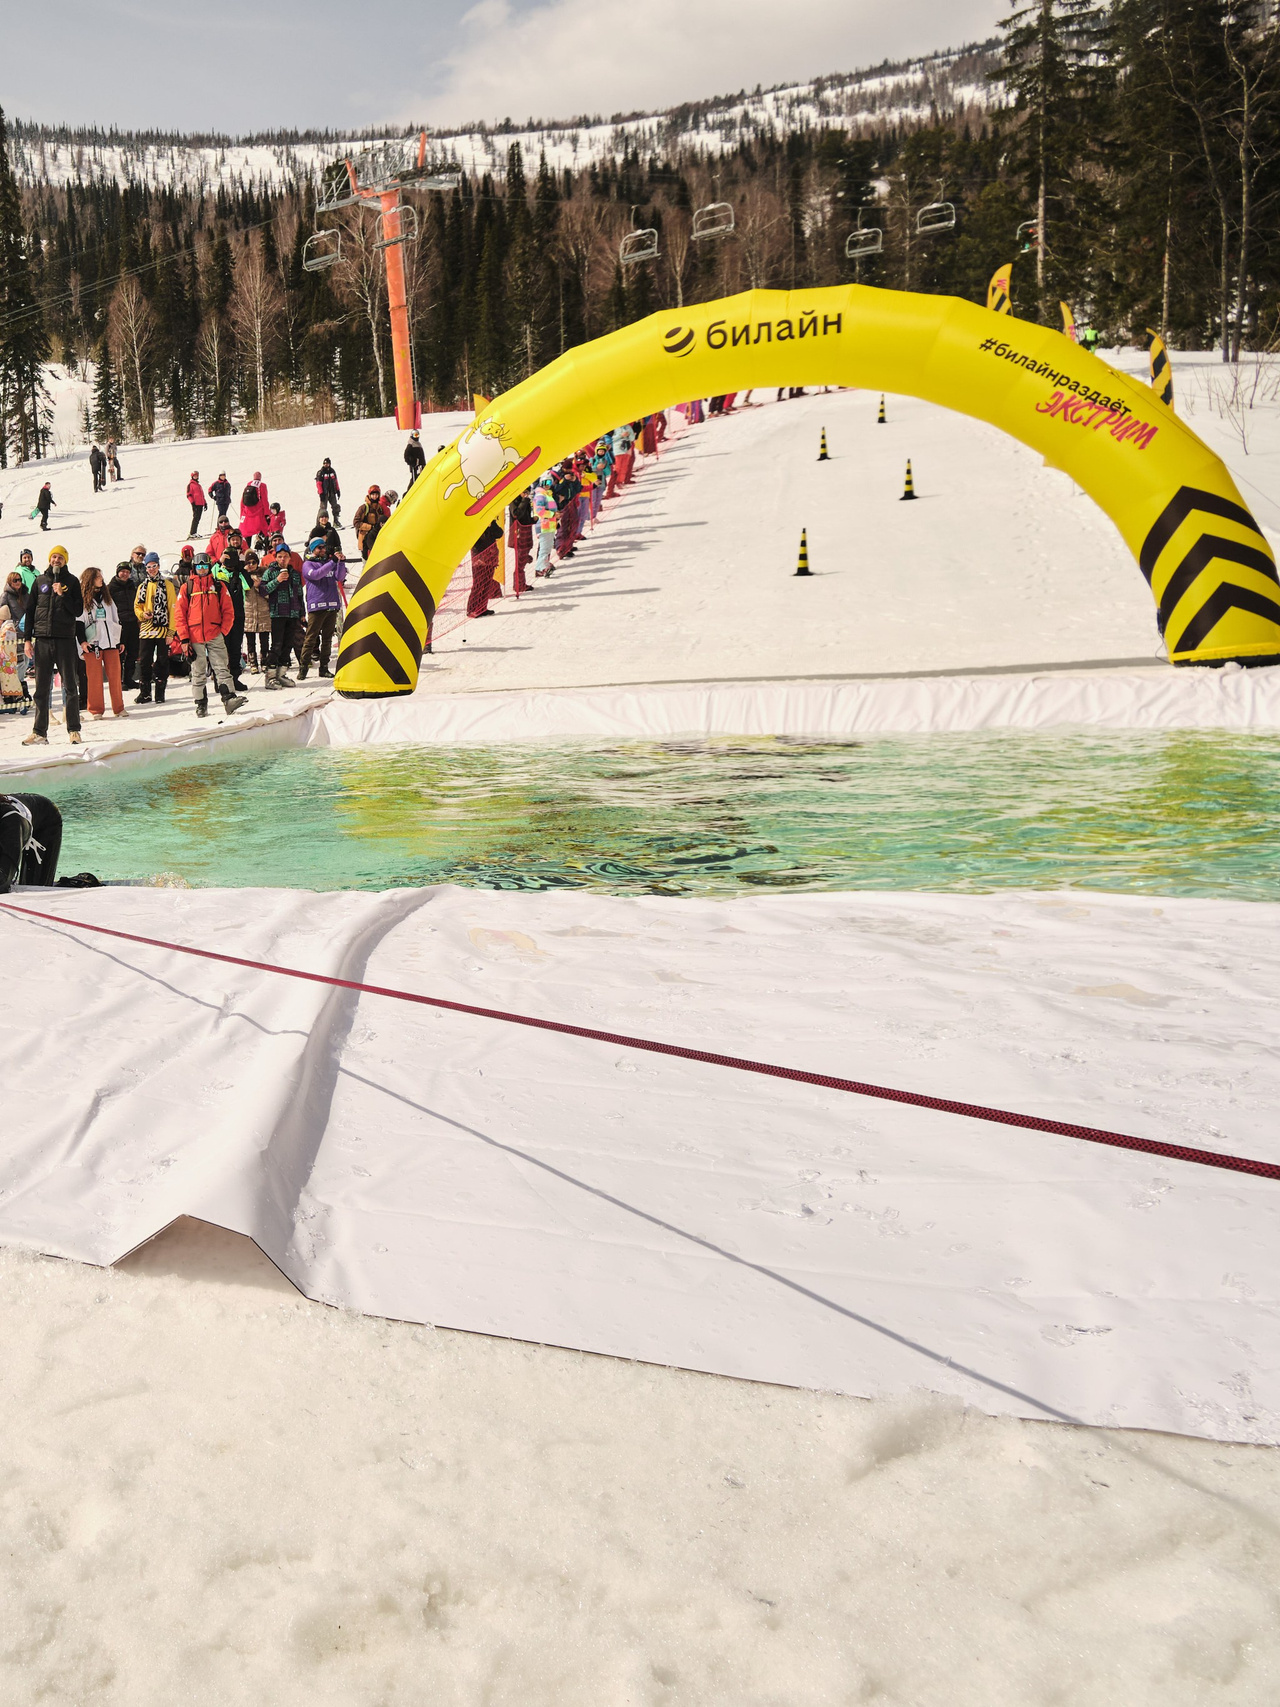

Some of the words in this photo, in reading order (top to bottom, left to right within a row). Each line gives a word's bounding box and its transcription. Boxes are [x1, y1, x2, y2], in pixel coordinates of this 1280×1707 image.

[706, 309, 842, 350] билайн
[979, 337, 1132, 417] #билайнраздаёт
[1036, 391, 1159, 450] ЭКСТРИМ
